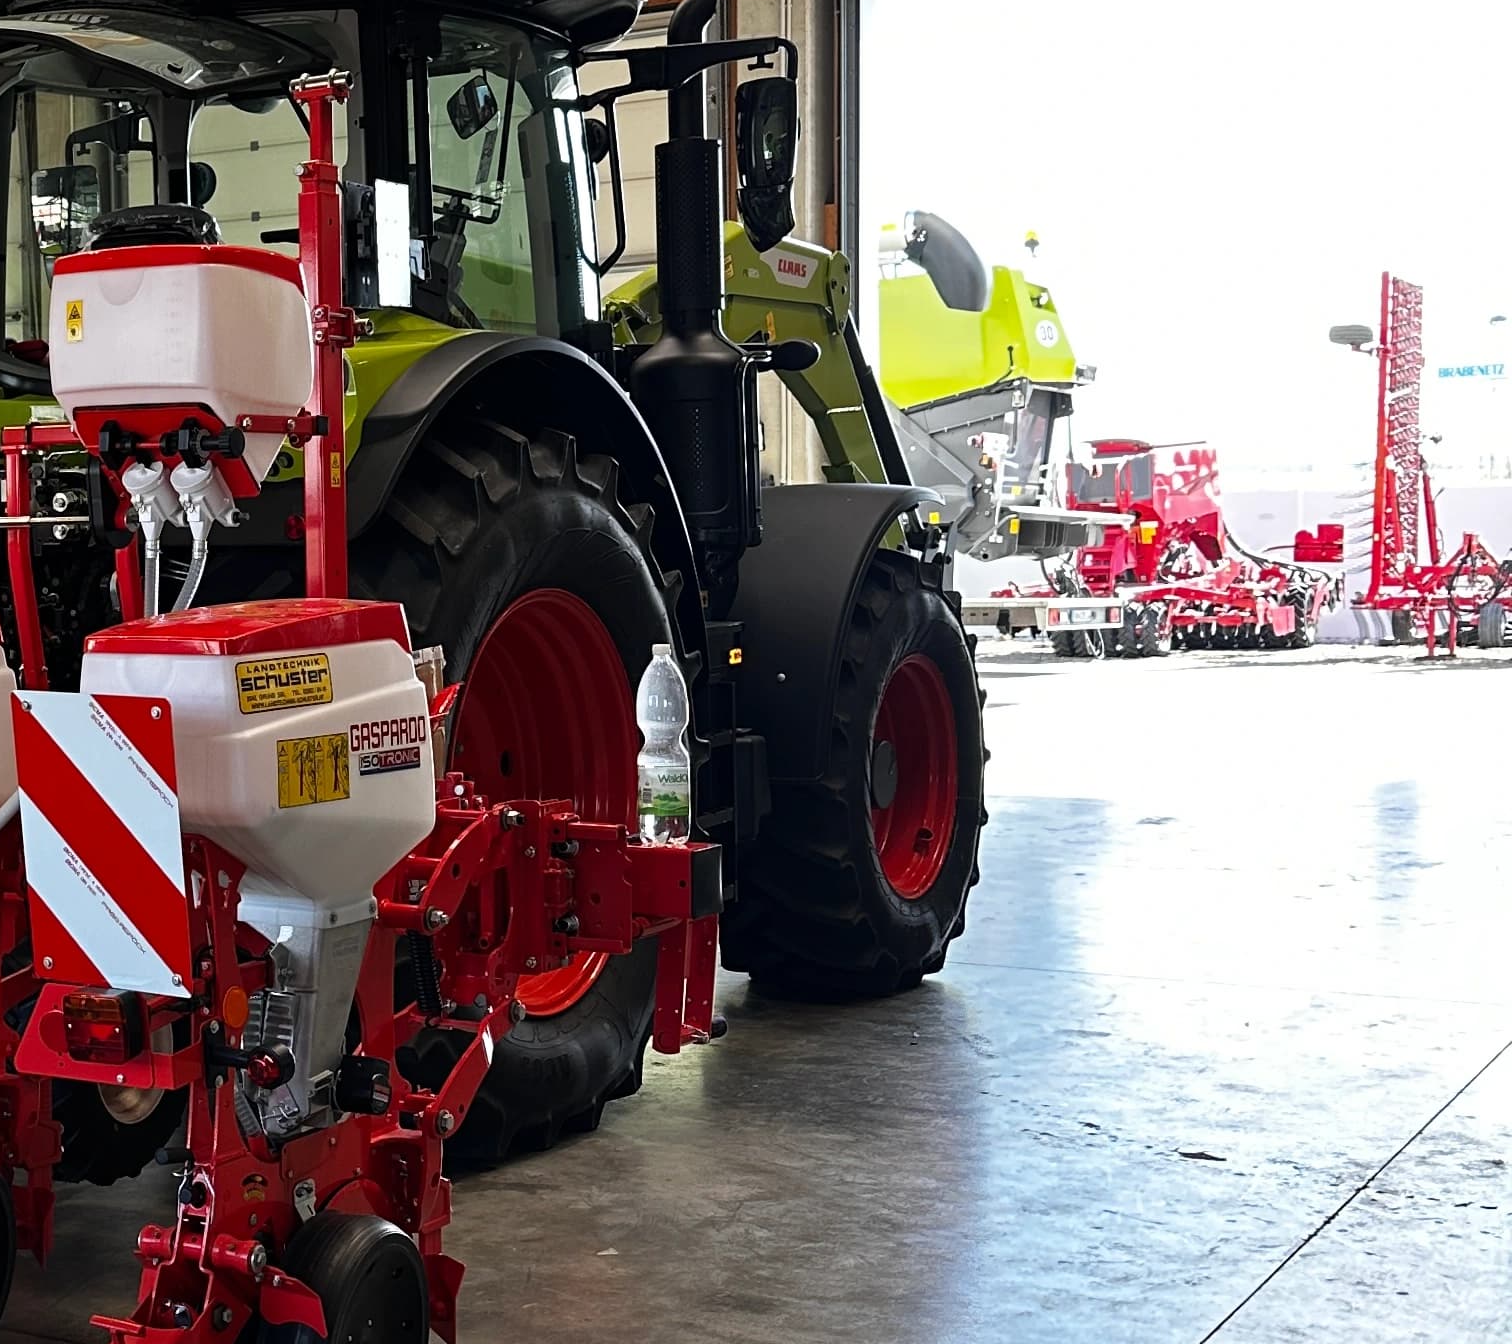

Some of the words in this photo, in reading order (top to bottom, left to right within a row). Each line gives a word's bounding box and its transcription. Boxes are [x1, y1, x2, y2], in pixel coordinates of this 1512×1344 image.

[777, 258, 807, 277] CLAAS
[246, 657, 321, 674] LANDTECHNIK
[350, 715, 427, 752] GASPARDO
